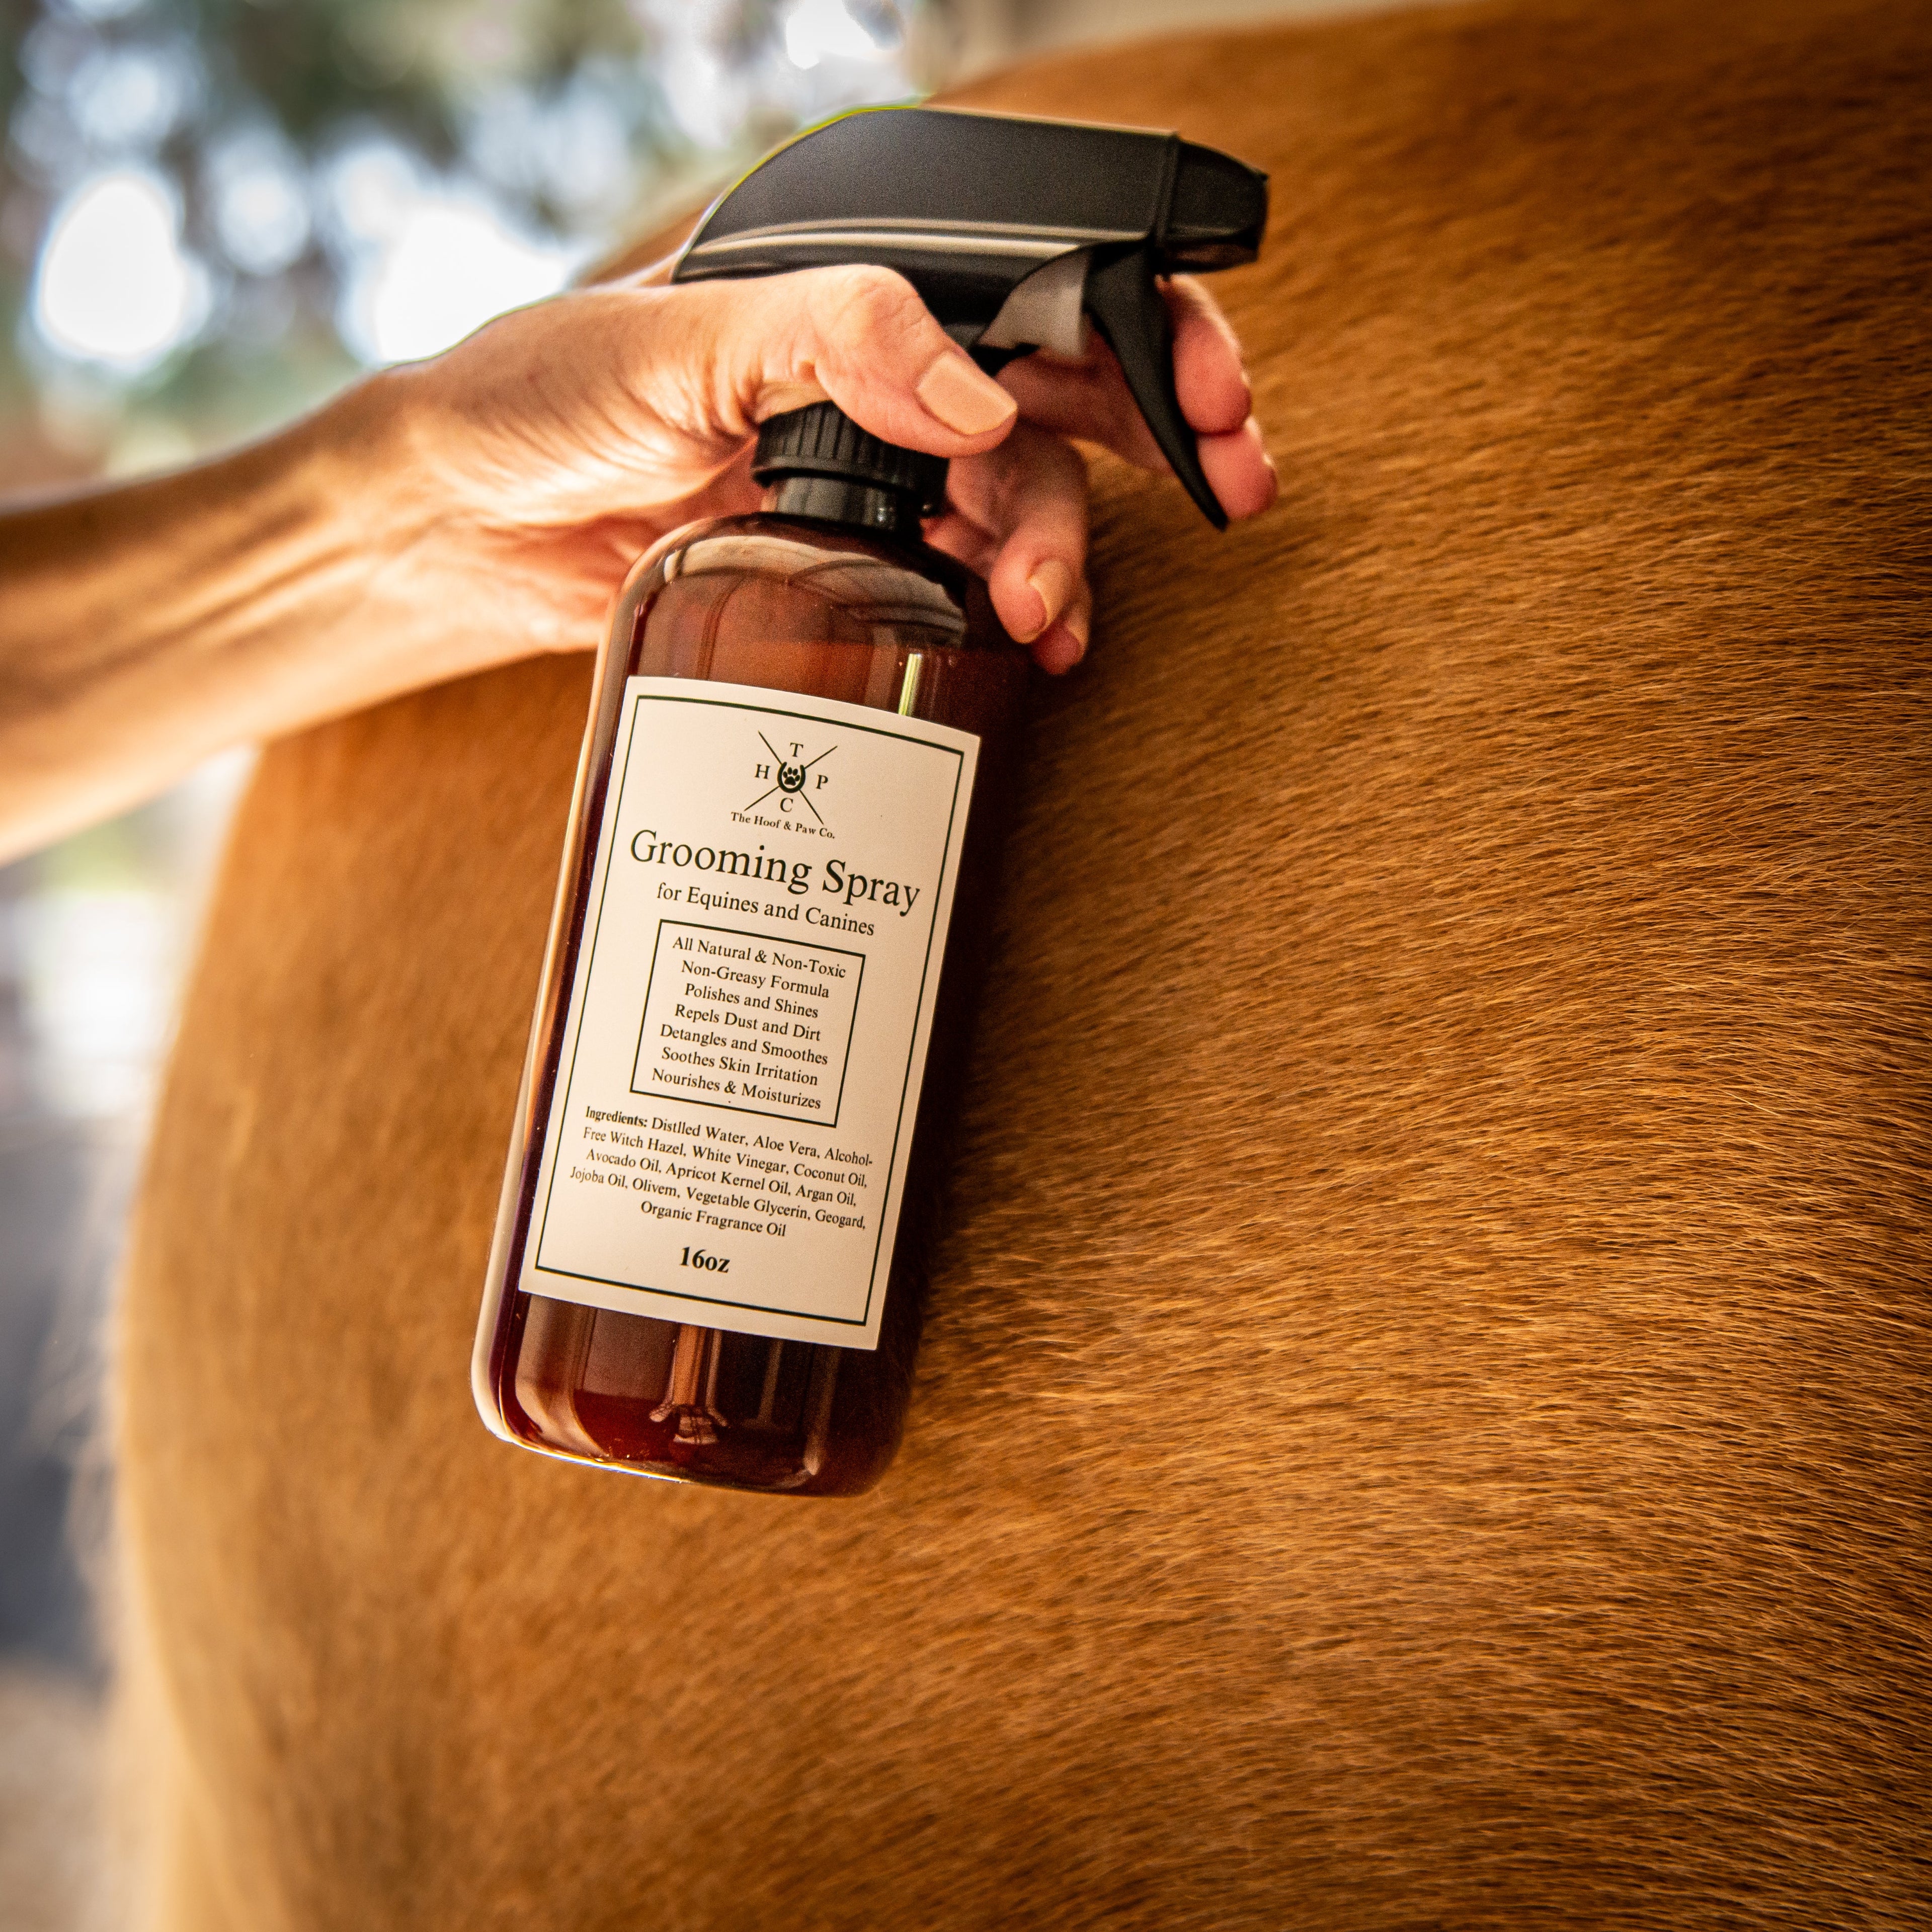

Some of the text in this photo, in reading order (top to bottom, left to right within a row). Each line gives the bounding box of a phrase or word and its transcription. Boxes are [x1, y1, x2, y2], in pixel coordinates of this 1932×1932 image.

[789, 742, 804, 758] T
[754, 764, 829, 790] H P
[780, 797, 793, 813] C
[731, 812, 835, 839] The Hoof & Paw Co.
[630, 829, 921, 917] Grooming Spray
[657, 882, 874, 936] for Equines and Canines
[672, 936, 846, 979] All Natural & Non-Toxic
[681, 960, 829, 998] Non-Greasy Formula
[684, 983, 819, 1019] Polishes and Shines
[675, 1003, 821, 1041] Repels Dust and Dirt
[660, 1023, 828, 1065] Detangles and Smoothes
[662, 1046, 818, 1086] Soothes Skin Irritation
[652, 1068, 821, 1109] Nourishes & Moisturizes
[586, 1106, 648, 1128] Ingredients:
[706, 1126, 749, 1147] Water,
[753, 1135, 784, 1152] Aloe
[789, 1140, 820, 1159] Vera,
[824, 1147, 873, 1167] Alcohol-
[583, 1126, 867, 1189] Free Witch Hazel, White Vinegar, Coconut Oil,
[570, 1166, 866, 1230] Jojoba Oil, Olivem, Vegetable Glycerin, Geogard,
[586, 1148, 856, 1208] Avocado Oil, Apricot Kernel Oil, Argan Oil,
[641, 1200, 786, 1237] Organic Fragrance Oil
[680, 1246, 731, 1273] 16oz
